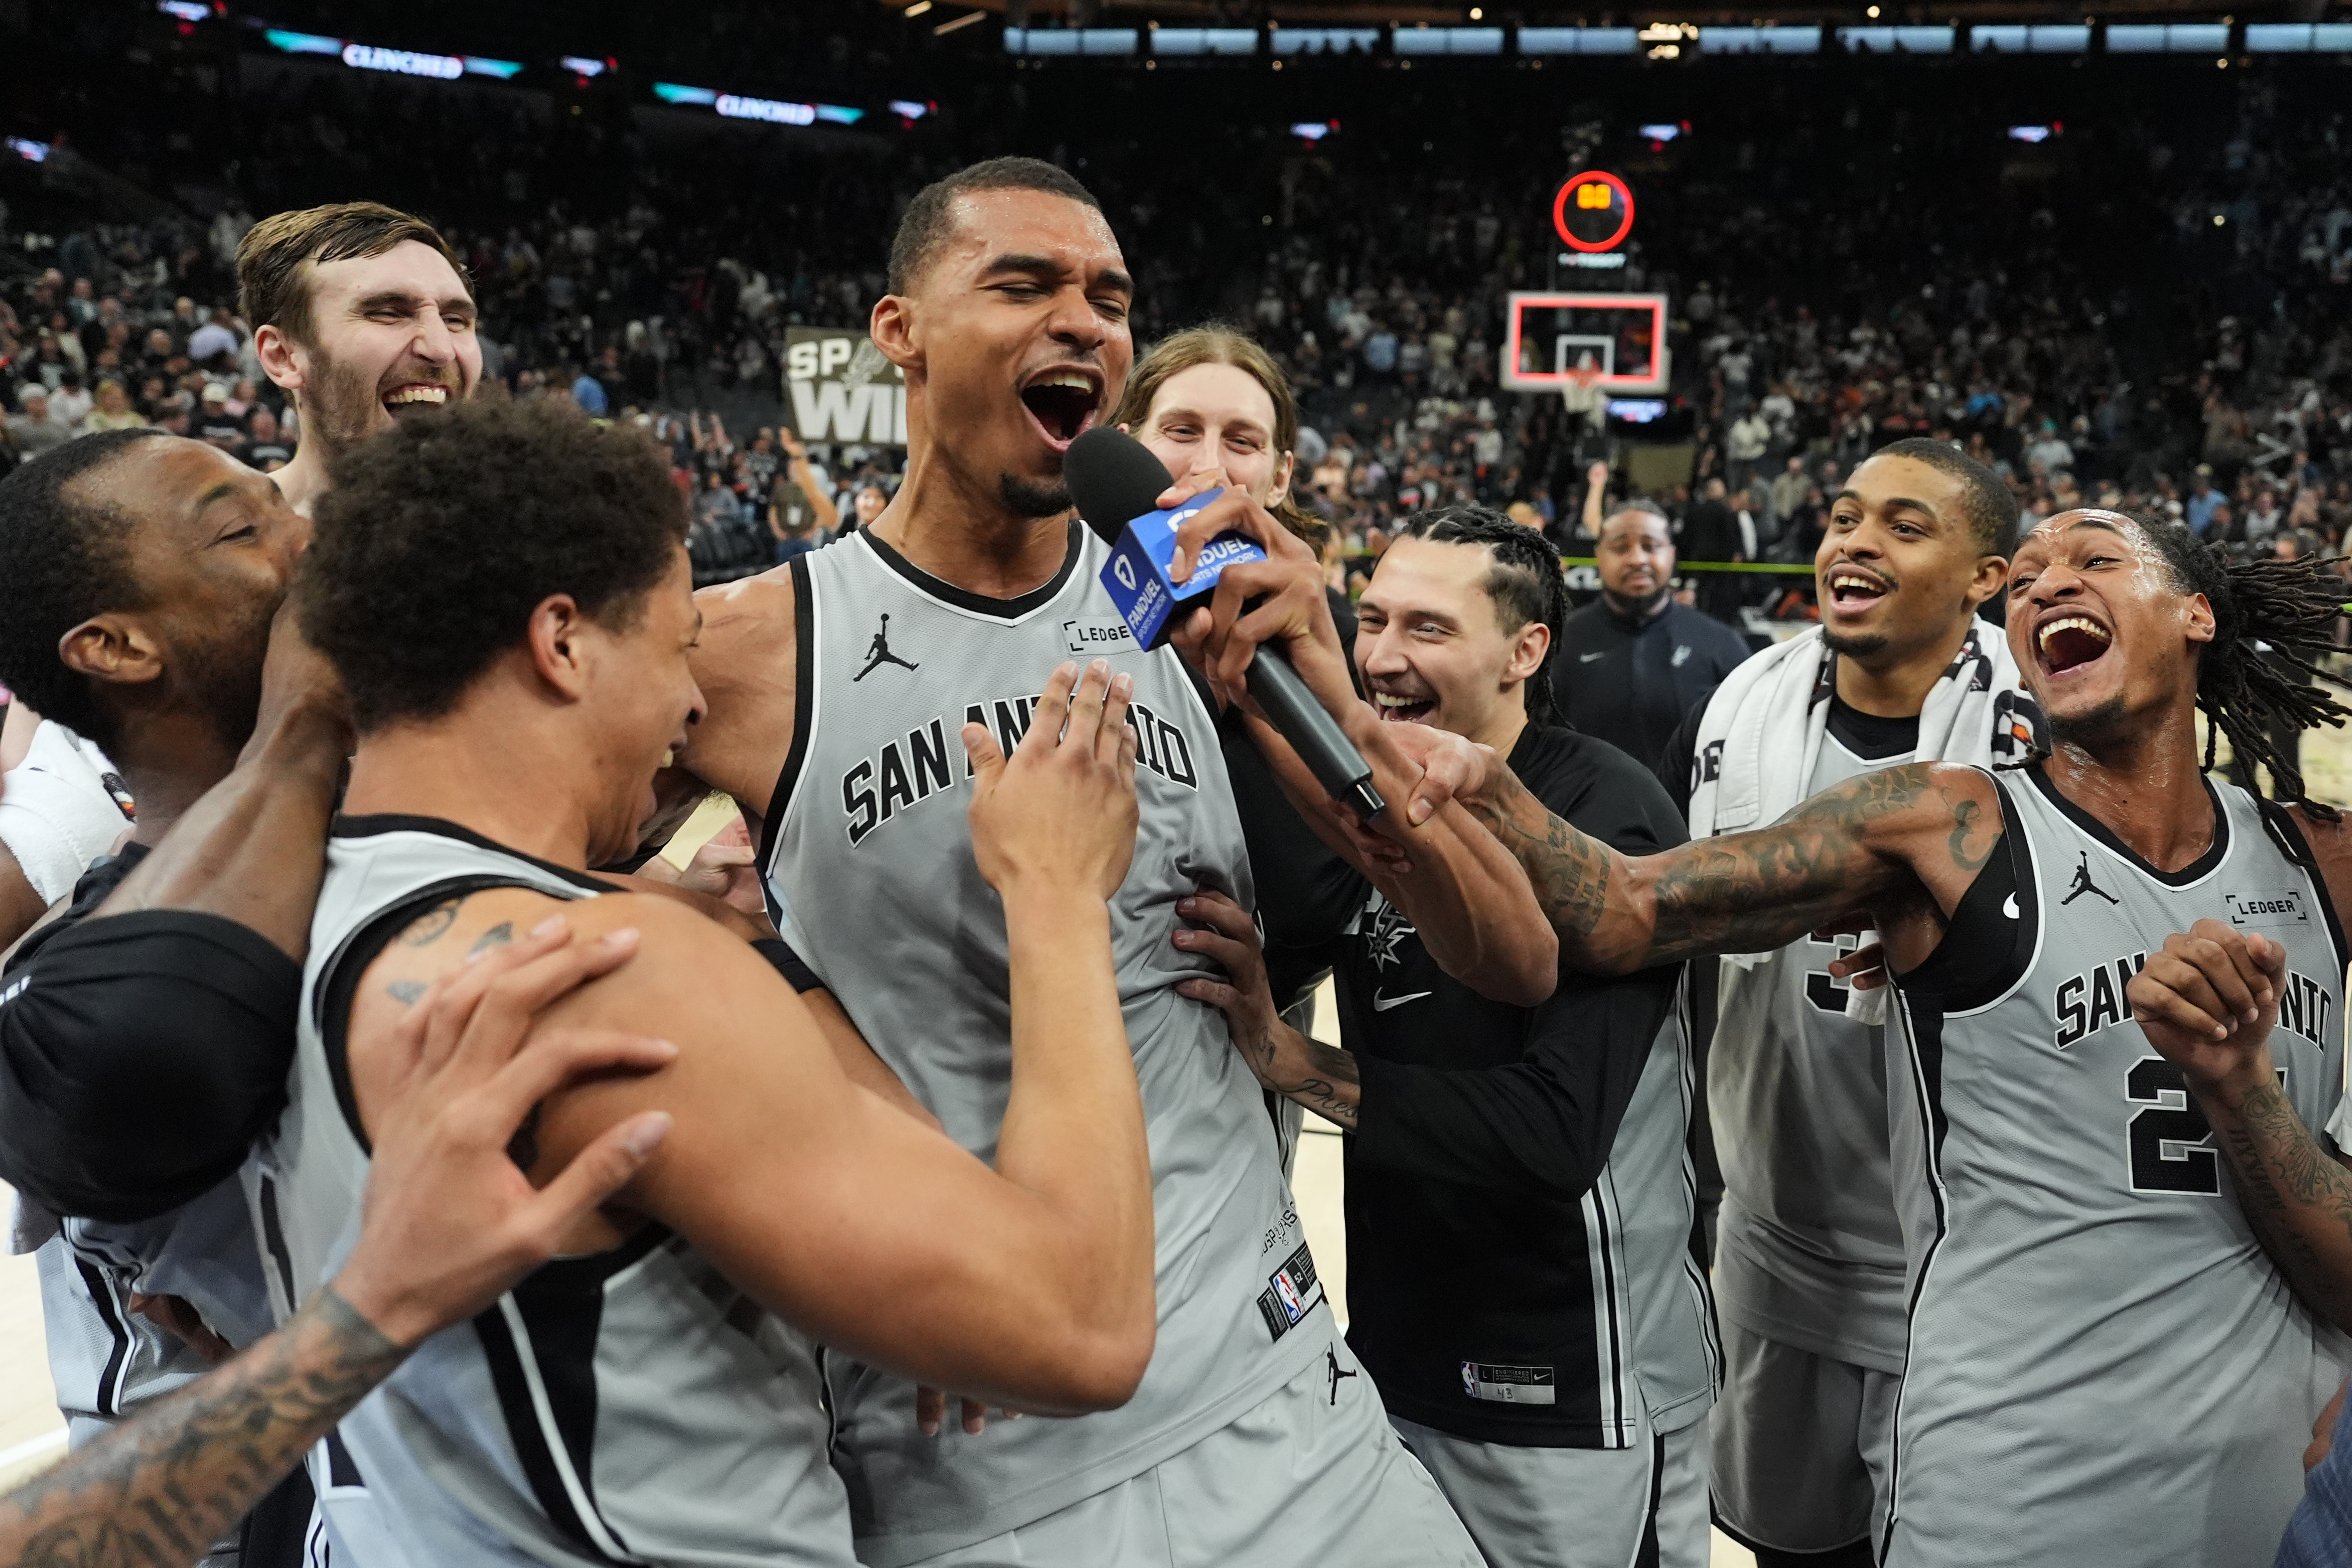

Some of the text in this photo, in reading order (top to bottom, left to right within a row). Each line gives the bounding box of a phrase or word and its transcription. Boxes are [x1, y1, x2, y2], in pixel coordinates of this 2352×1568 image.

[1128, 579, 1161, 631] FANDUEL
[1078, 625, 1130, 641] LEDGE
[841, 715, 954, 848] SAN
[2238, 900, 2296, 915] LEDGER
[2124, 1055, 2288, 1198] 2
[1294, 1272, 1304, 1284] 52
[1482, 1370, 1488, 1378] L
[1497, 1388, 1513, 1399] 43
